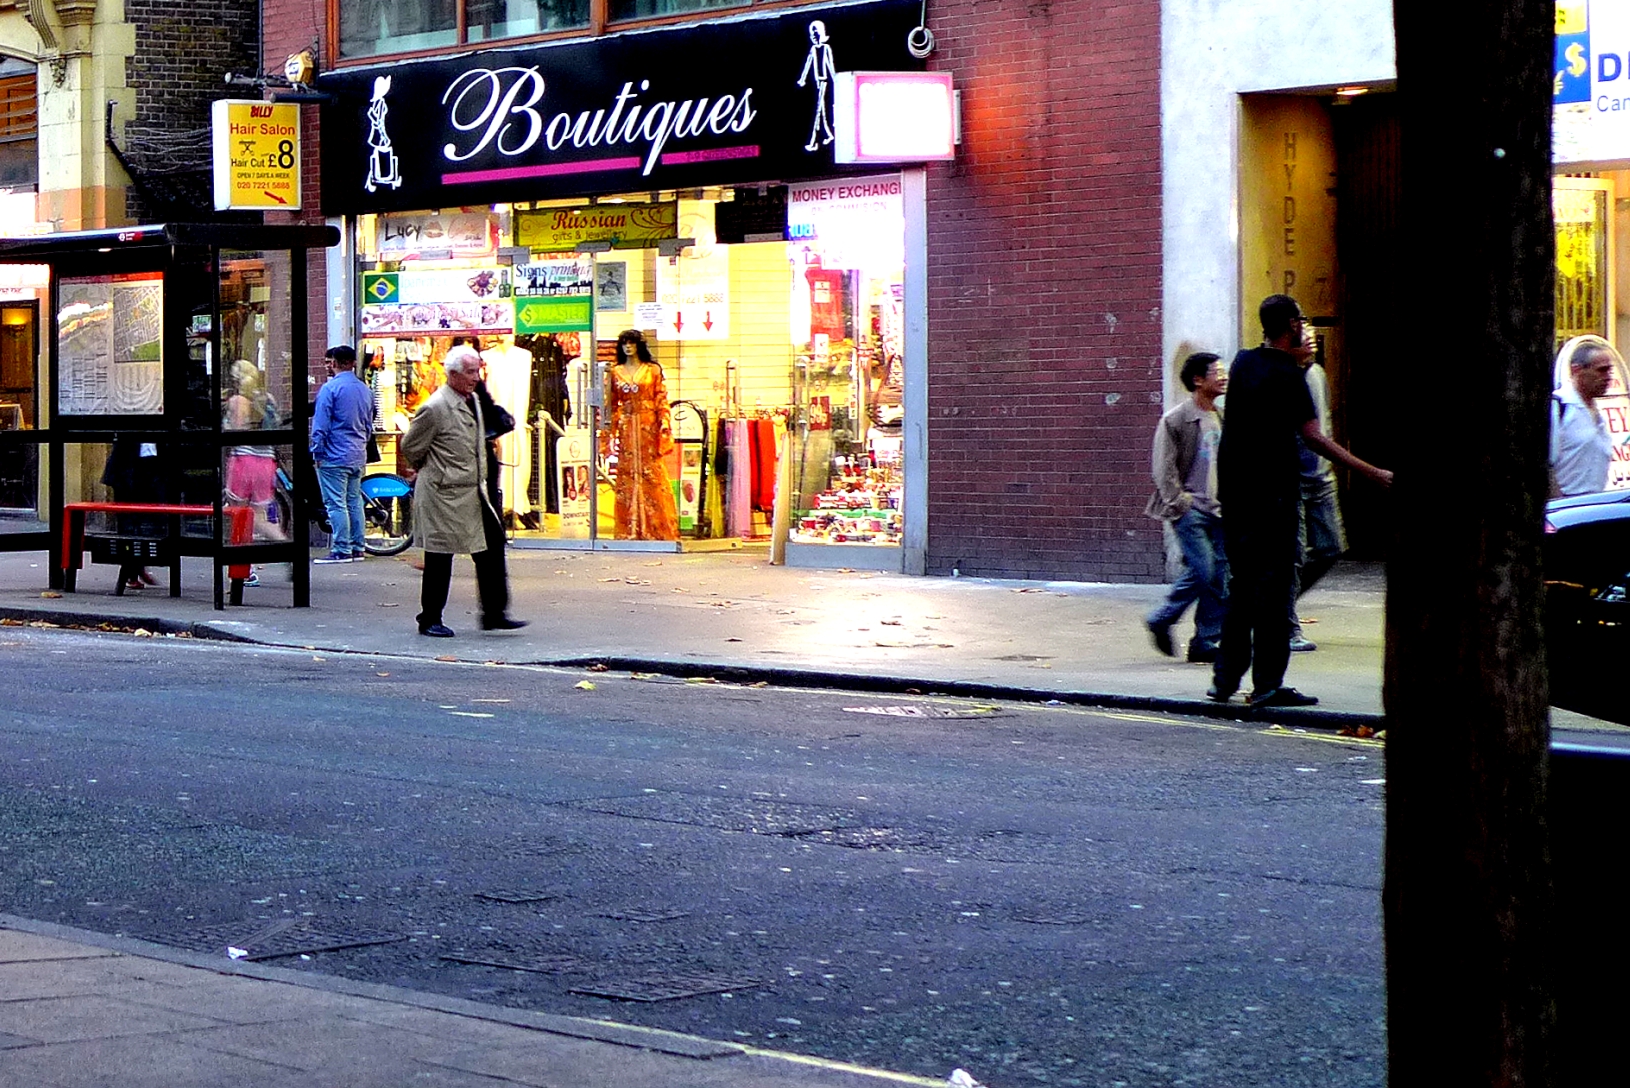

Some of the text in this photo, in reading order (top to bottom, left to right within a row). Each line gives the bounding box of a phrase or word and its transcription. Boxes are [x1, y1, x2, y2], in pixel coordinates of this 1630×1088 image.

[230, 123, 296, 135] Hair Salon
[441, 64, 758, 177] Boutiques
[231, 158, 248, 168] Hair
[250, 158, 265, 168] Cut
[792, 188, 835, 203] MONEY
[1283, 131, 1297, 256] HYDE
[551, 210, 626, 231] Russian
[385, 221, 422, 242] Lucy
[552, 230, 573, 243] gifts
[575, 230, 582, 240] &
[516, 263, 547, 280] Signs
